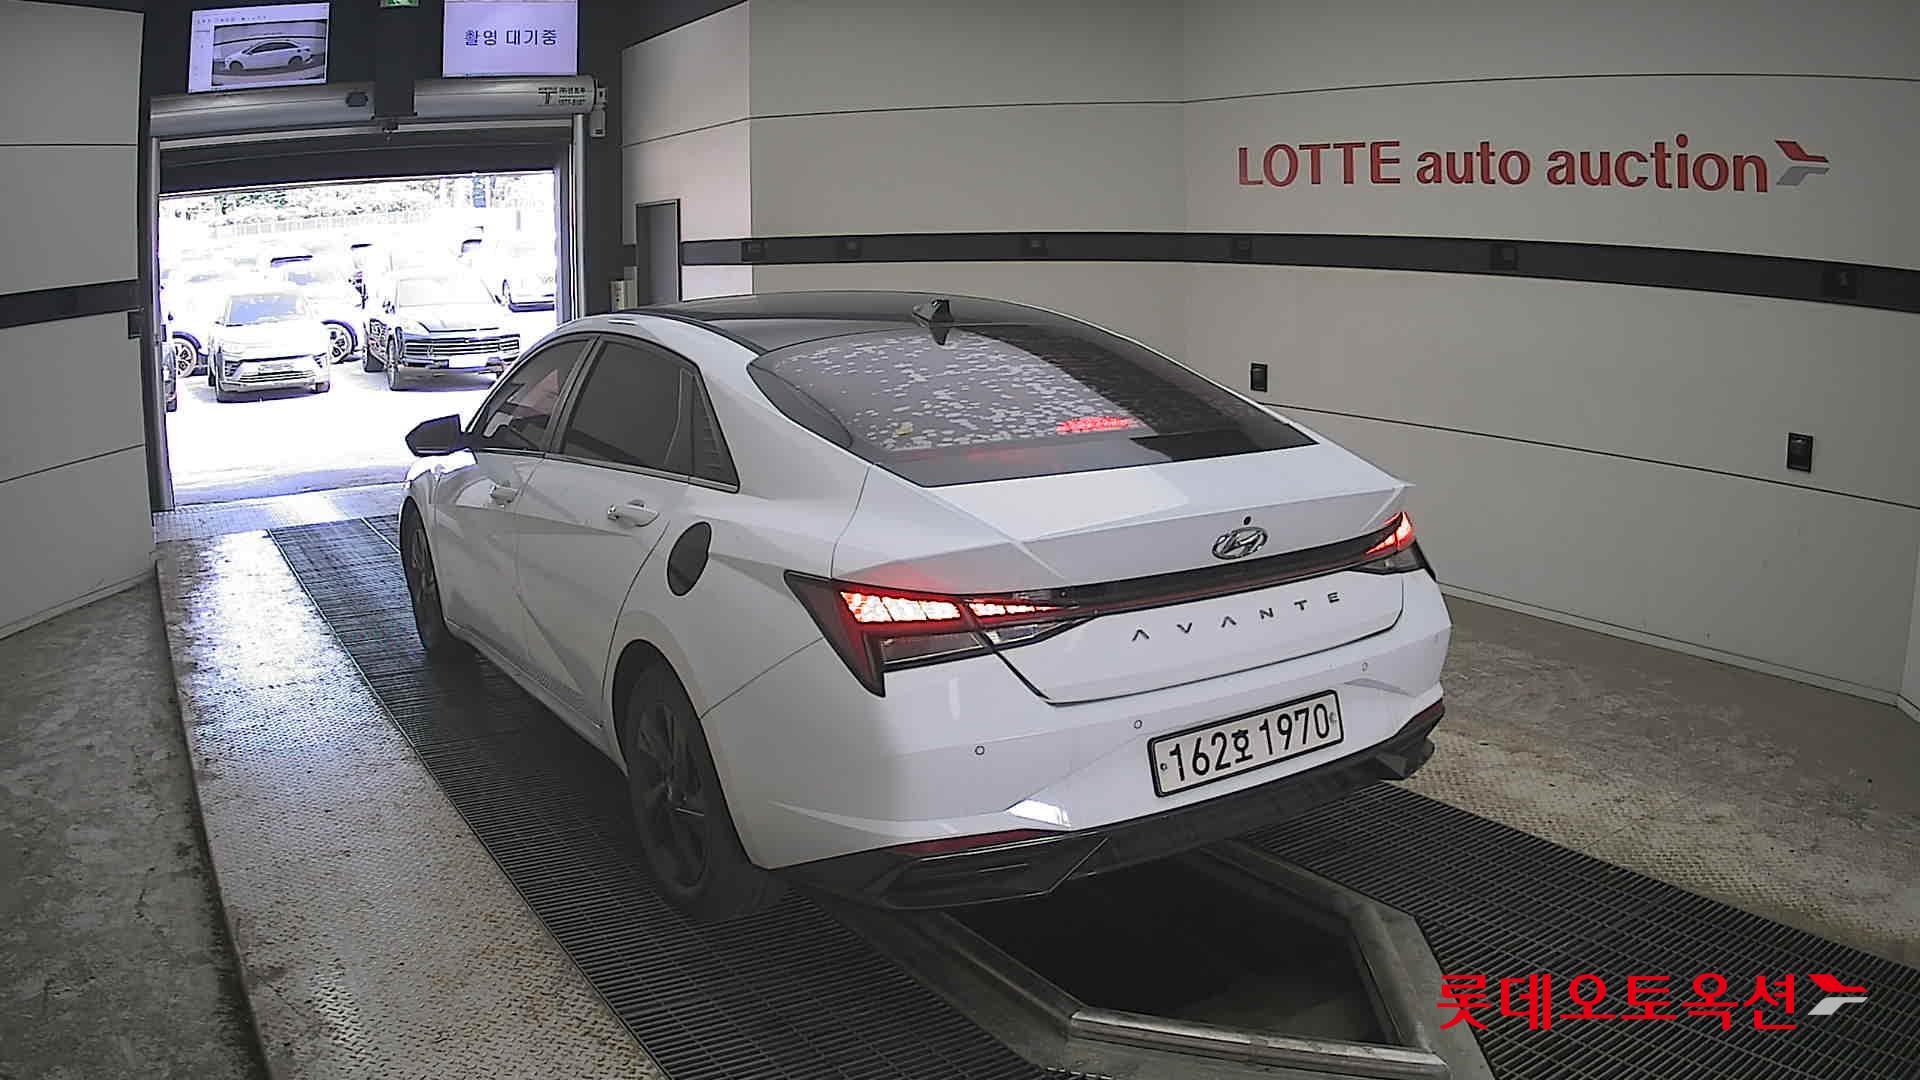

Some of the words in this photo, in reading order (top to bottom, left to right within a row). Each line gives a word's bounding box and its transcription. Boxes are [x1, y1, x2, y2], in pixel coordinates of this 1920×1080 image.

[464, 29, 497, 46] 촬영
[506, 29, 558, 46] 대기중
[1238, 140, 1400, 187] LOTTE
[1416, 140, 1531, 185] auto
[1547, 134, 1768, 192] auction
[1132, 592, 1341, 642] AVANTE
